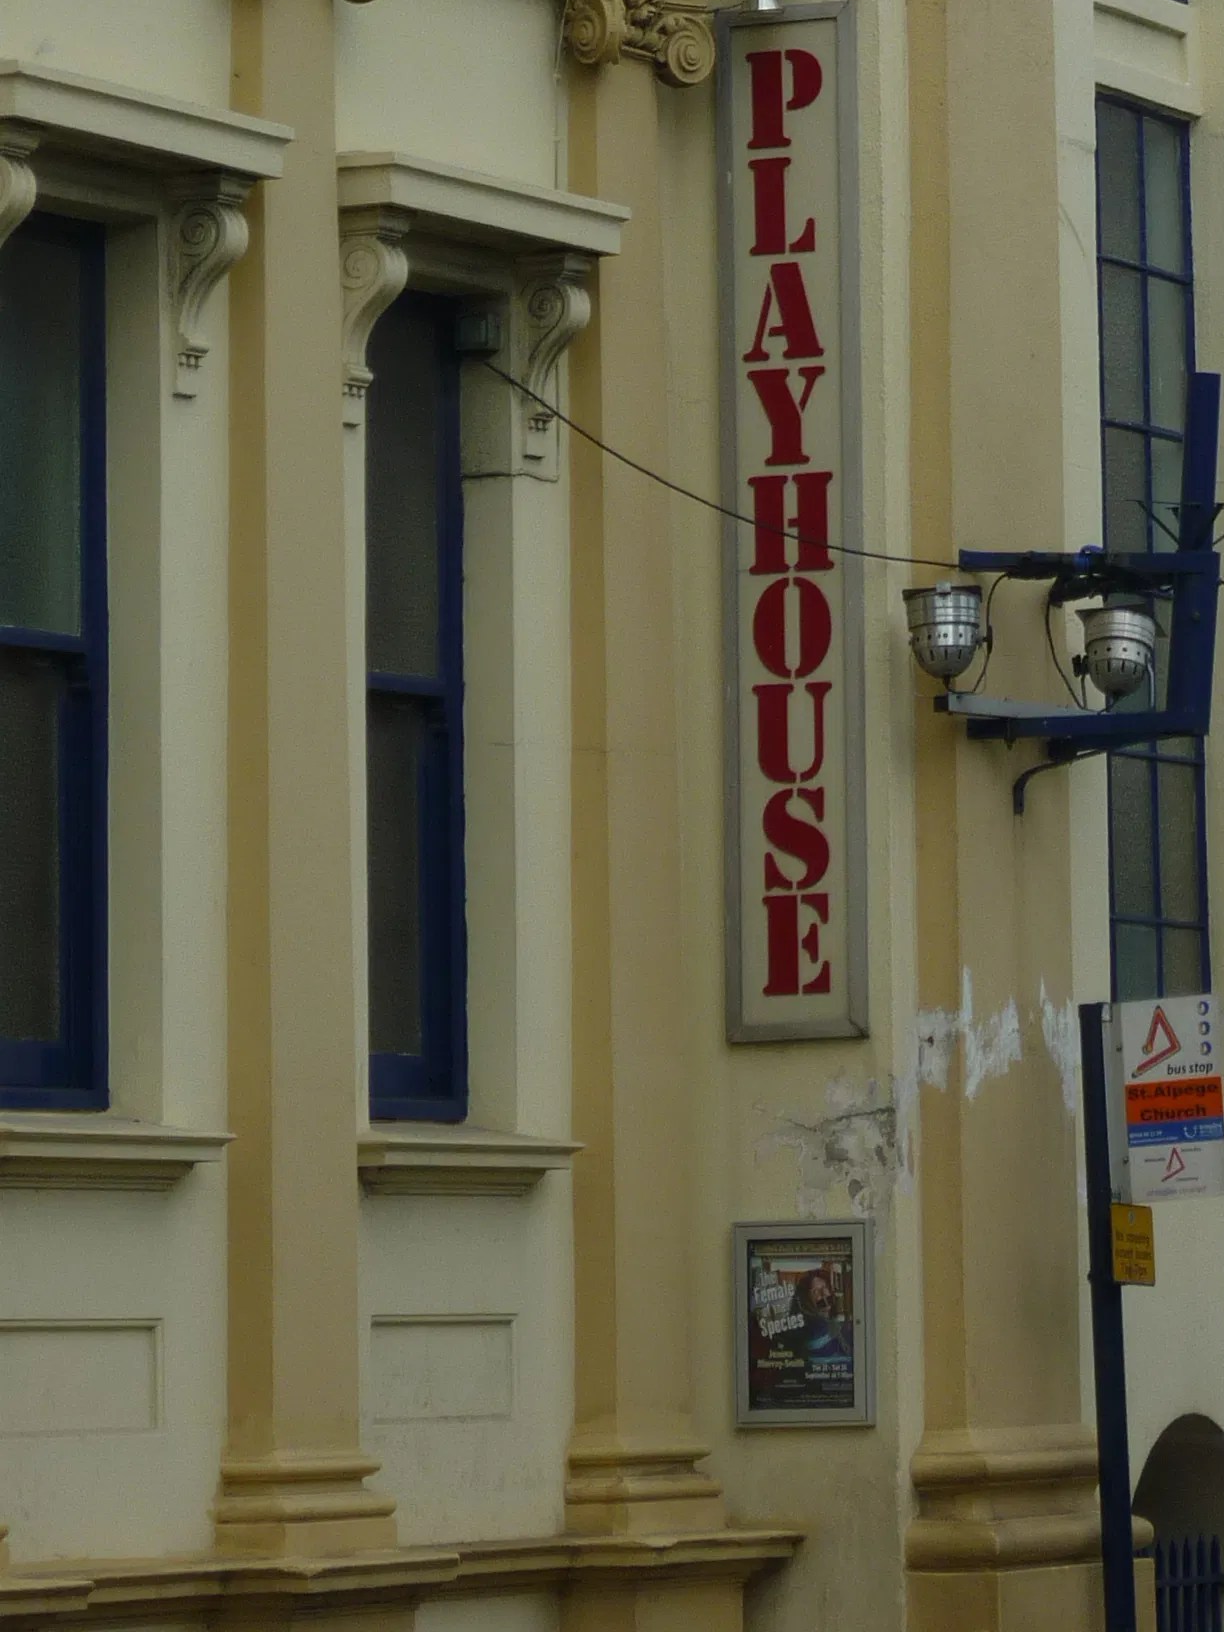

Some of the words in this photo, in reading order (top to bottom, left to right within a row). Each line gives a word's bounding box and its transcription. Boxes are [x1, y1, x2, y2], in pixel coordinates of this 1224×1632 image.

[743, 48, 835, 997] PLAYHOUSE
[1166, 1063, 1187, 1075] bus
[1188, 1062, 1214, 1075] stop
[1140, 1103, 1207, 1122] Church
[754, 1281, 796, 1305] Female
[758, 1313, 805, 1340] Species
